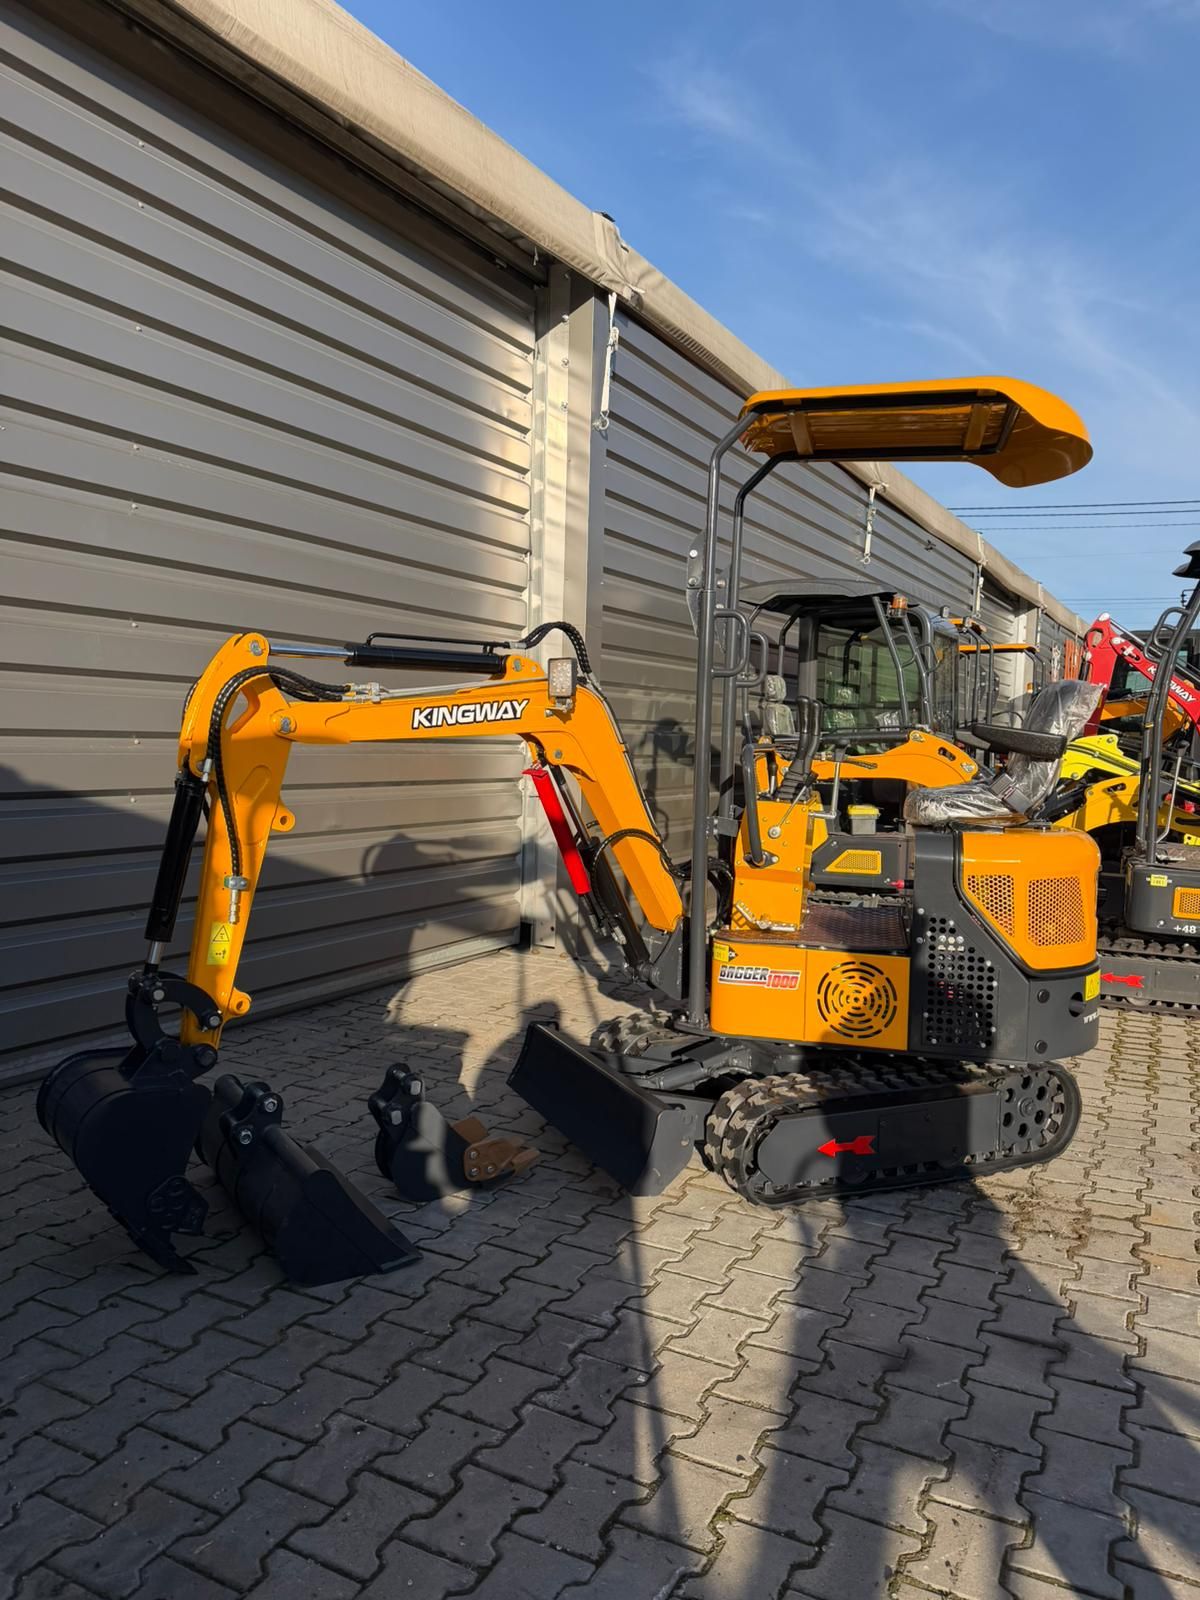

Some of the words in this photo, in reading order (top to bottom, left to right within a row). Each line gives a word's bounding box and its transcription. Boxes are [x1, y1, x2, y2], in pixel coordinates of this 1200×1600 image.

[411, 699, 530, 729] KINGWAY
[1173, 924, 1197, 934] +48
[719, 964, 770, 981] BAGGER
[766, 974, 799, 988] 1000
